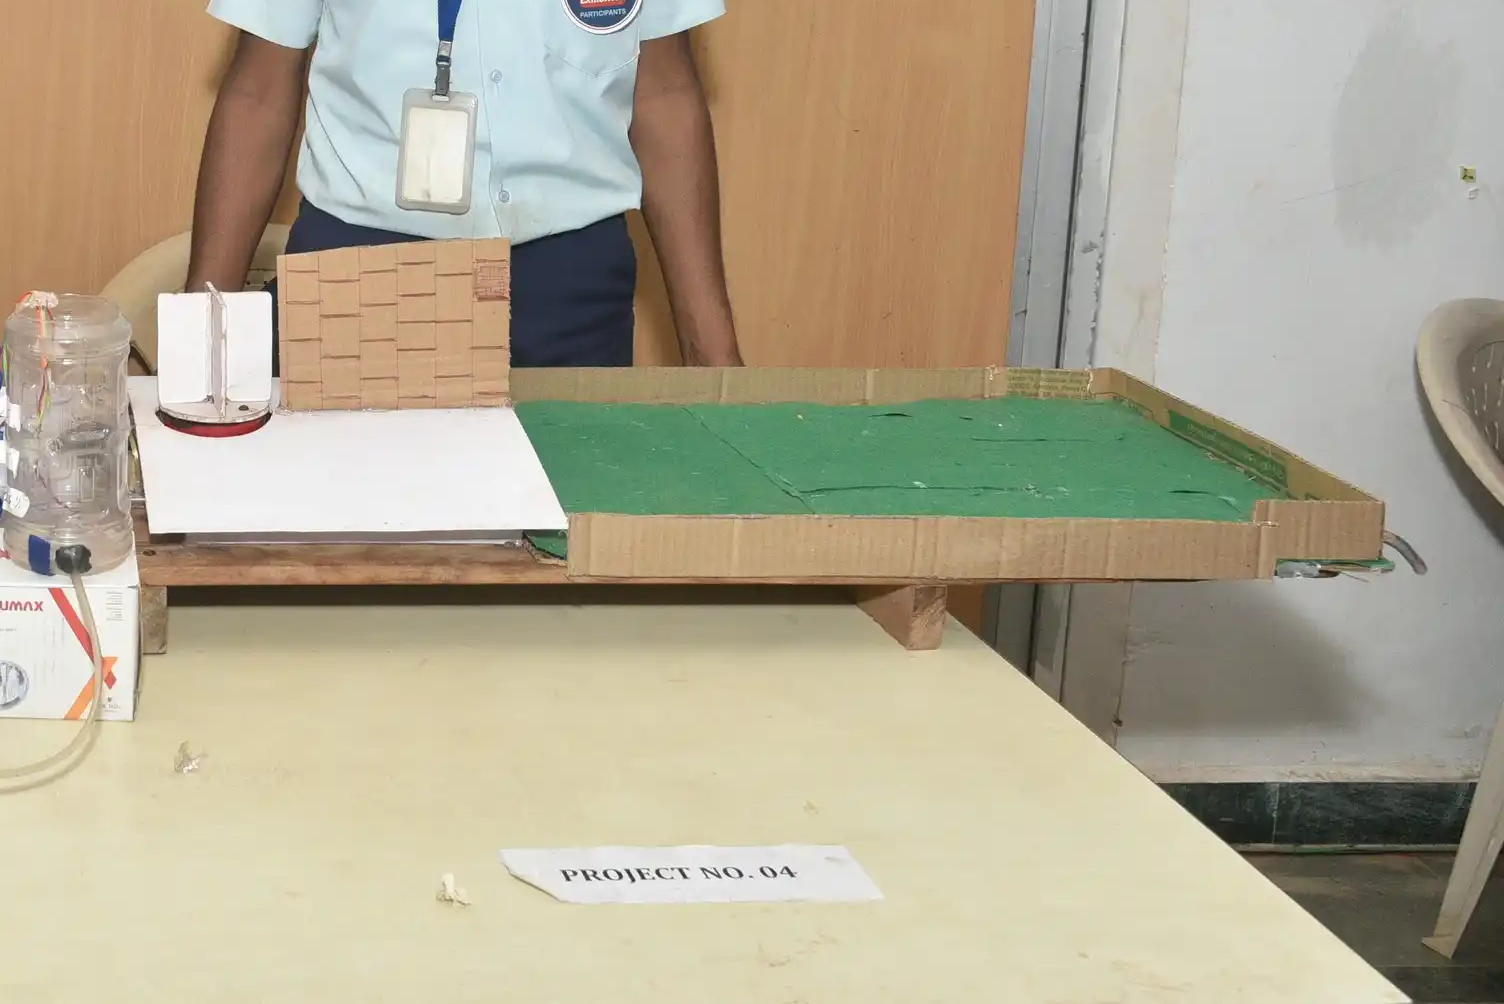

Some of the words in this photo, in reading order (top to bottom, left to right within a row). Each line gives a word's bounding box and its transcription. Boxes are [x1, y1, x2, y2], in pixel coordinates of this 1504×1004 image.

[580, 8, 626, 17] PARTICIPANTS
[559, 866, 691, 884] PROJECT
[699, 865, 754, 881] NO.
[758, 864, 799, 881] 04
